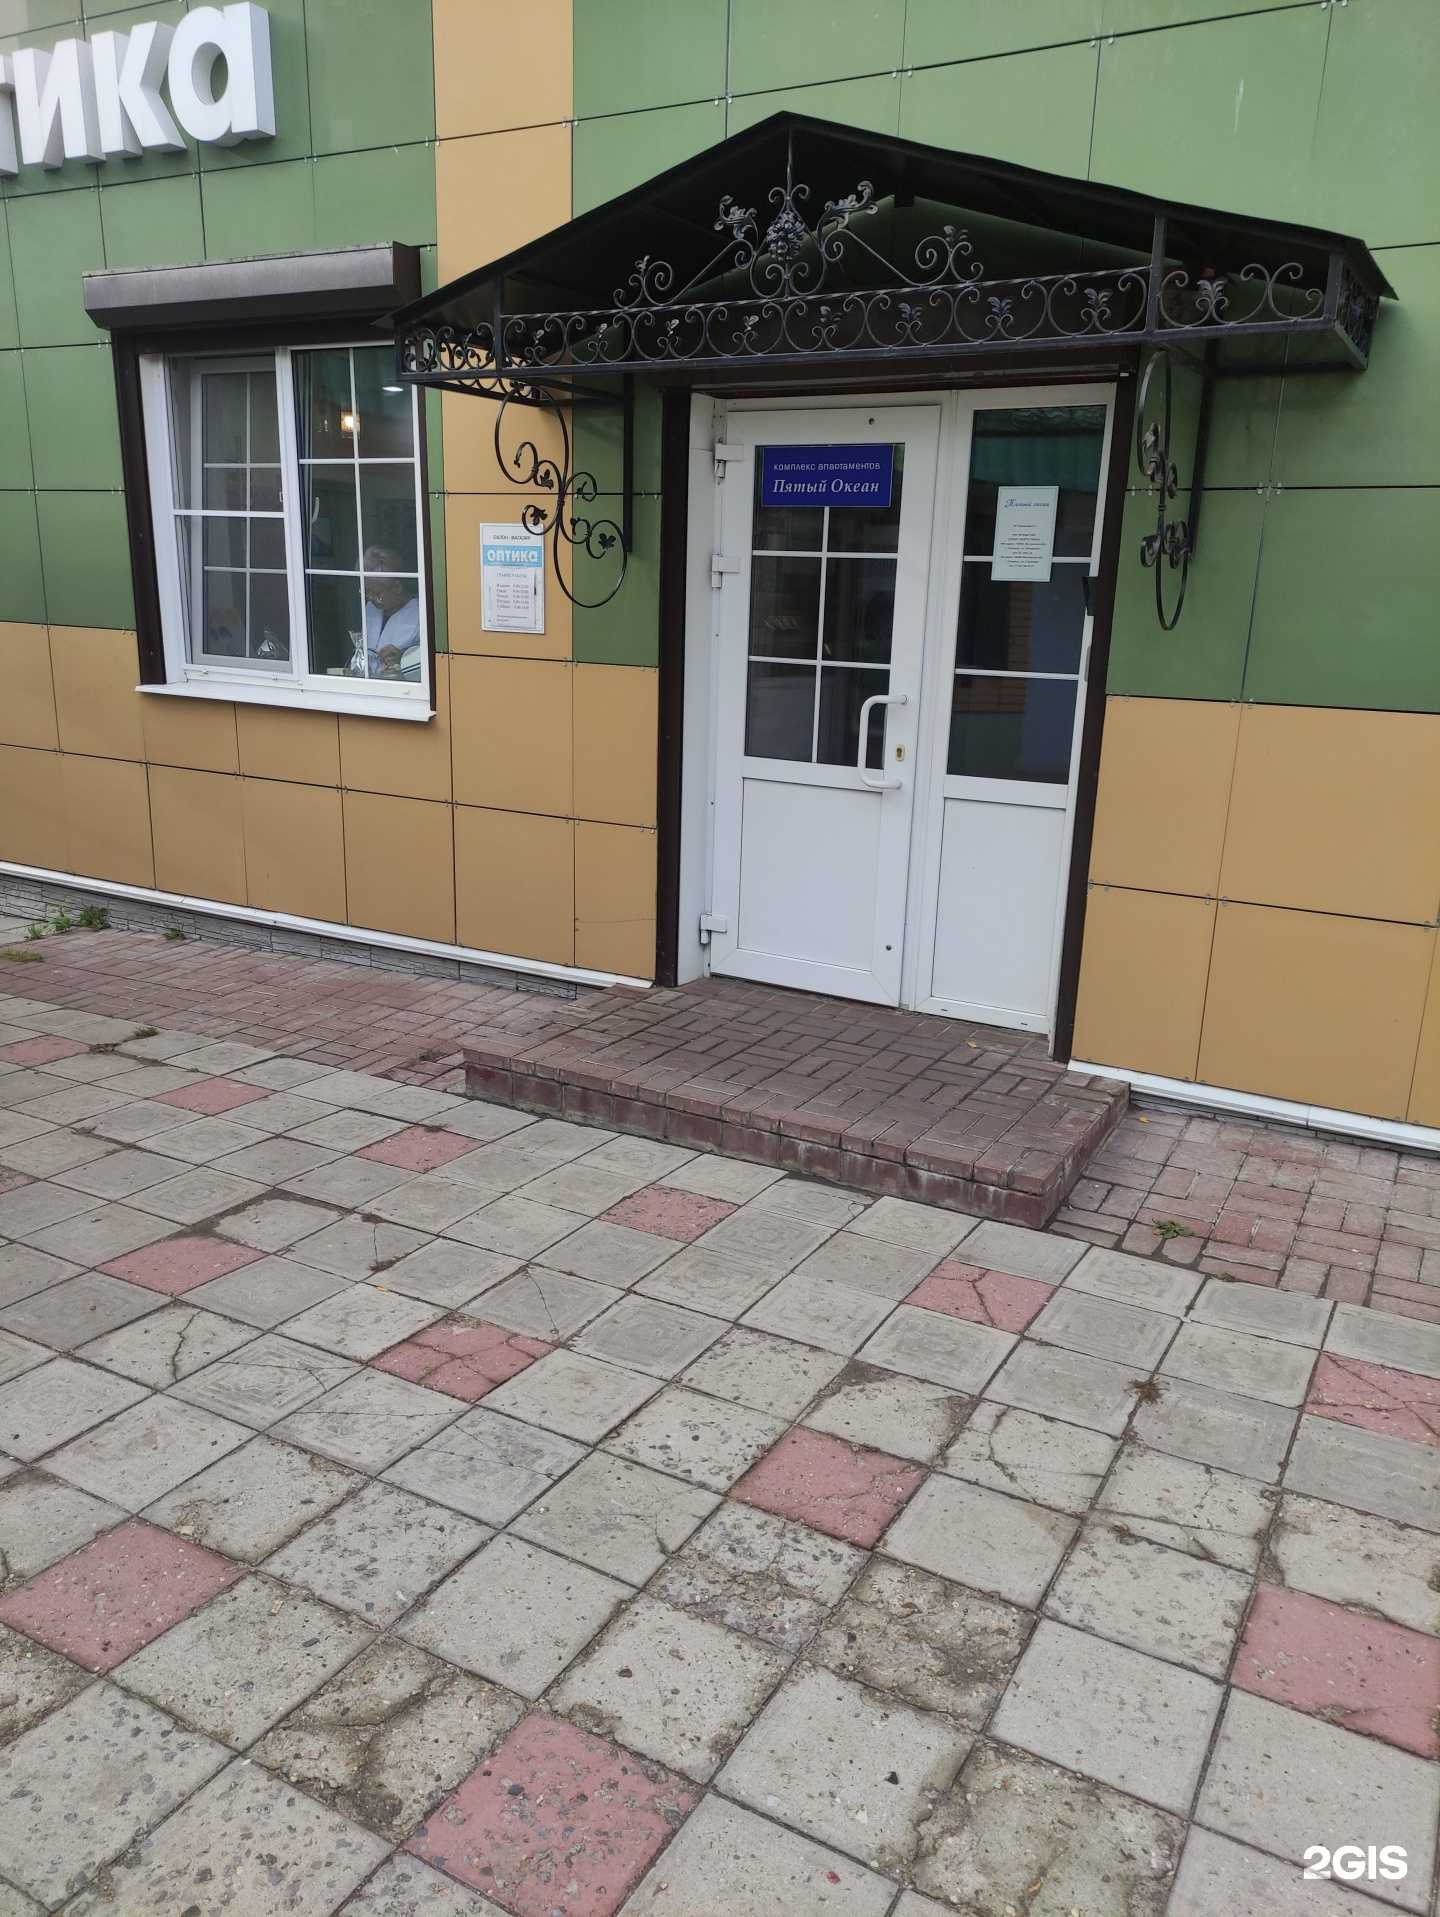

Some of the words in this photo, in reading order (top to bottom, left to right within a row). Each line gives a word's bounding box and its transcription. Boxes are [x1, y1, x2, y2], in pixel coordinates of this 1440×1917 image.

[0, 2, 276, 175] ика
[773, 462, 816, 472] комплекс
[818, 461, 881, 471] апартаментов
[773, 479, 828, 493] Пятый
[831, 478, 879, 493] Океан
